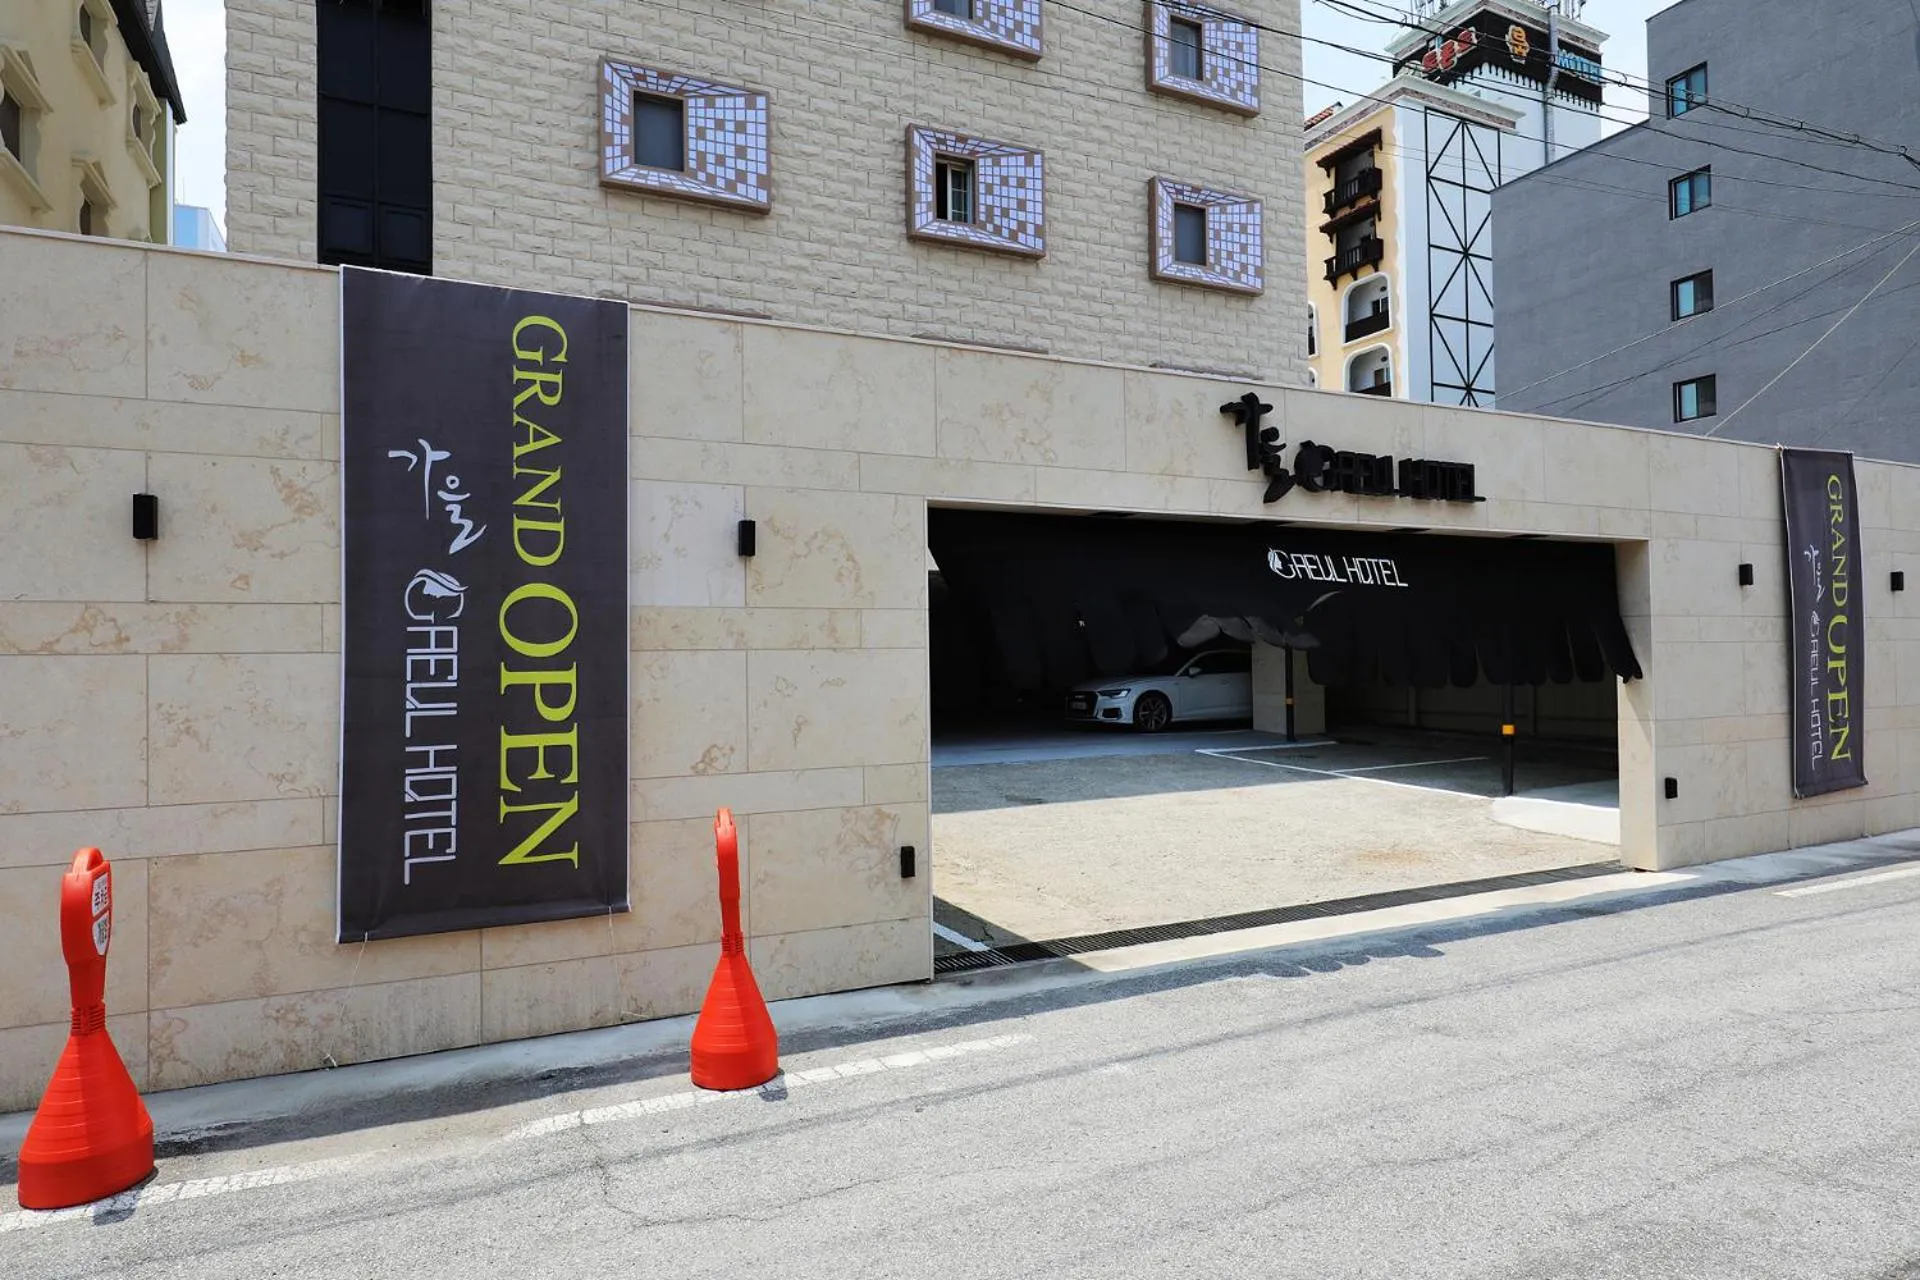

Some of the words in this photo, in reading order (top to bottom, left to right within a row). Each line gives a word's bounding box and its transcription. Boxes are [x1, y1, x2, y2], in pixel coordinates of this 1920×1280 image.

[512, 315, 568, 567] GRAND
[1343, 556, 1409, 587] HOTEL
[1827, 474, 1849, 608] GRAND
[498, 582, 579, 868] OPEN
[1810, 699, 1824, 771] HOTEL
[1827, 614, 1852, 762] OPEN
[404, 745, 458, 886] HOTEL
